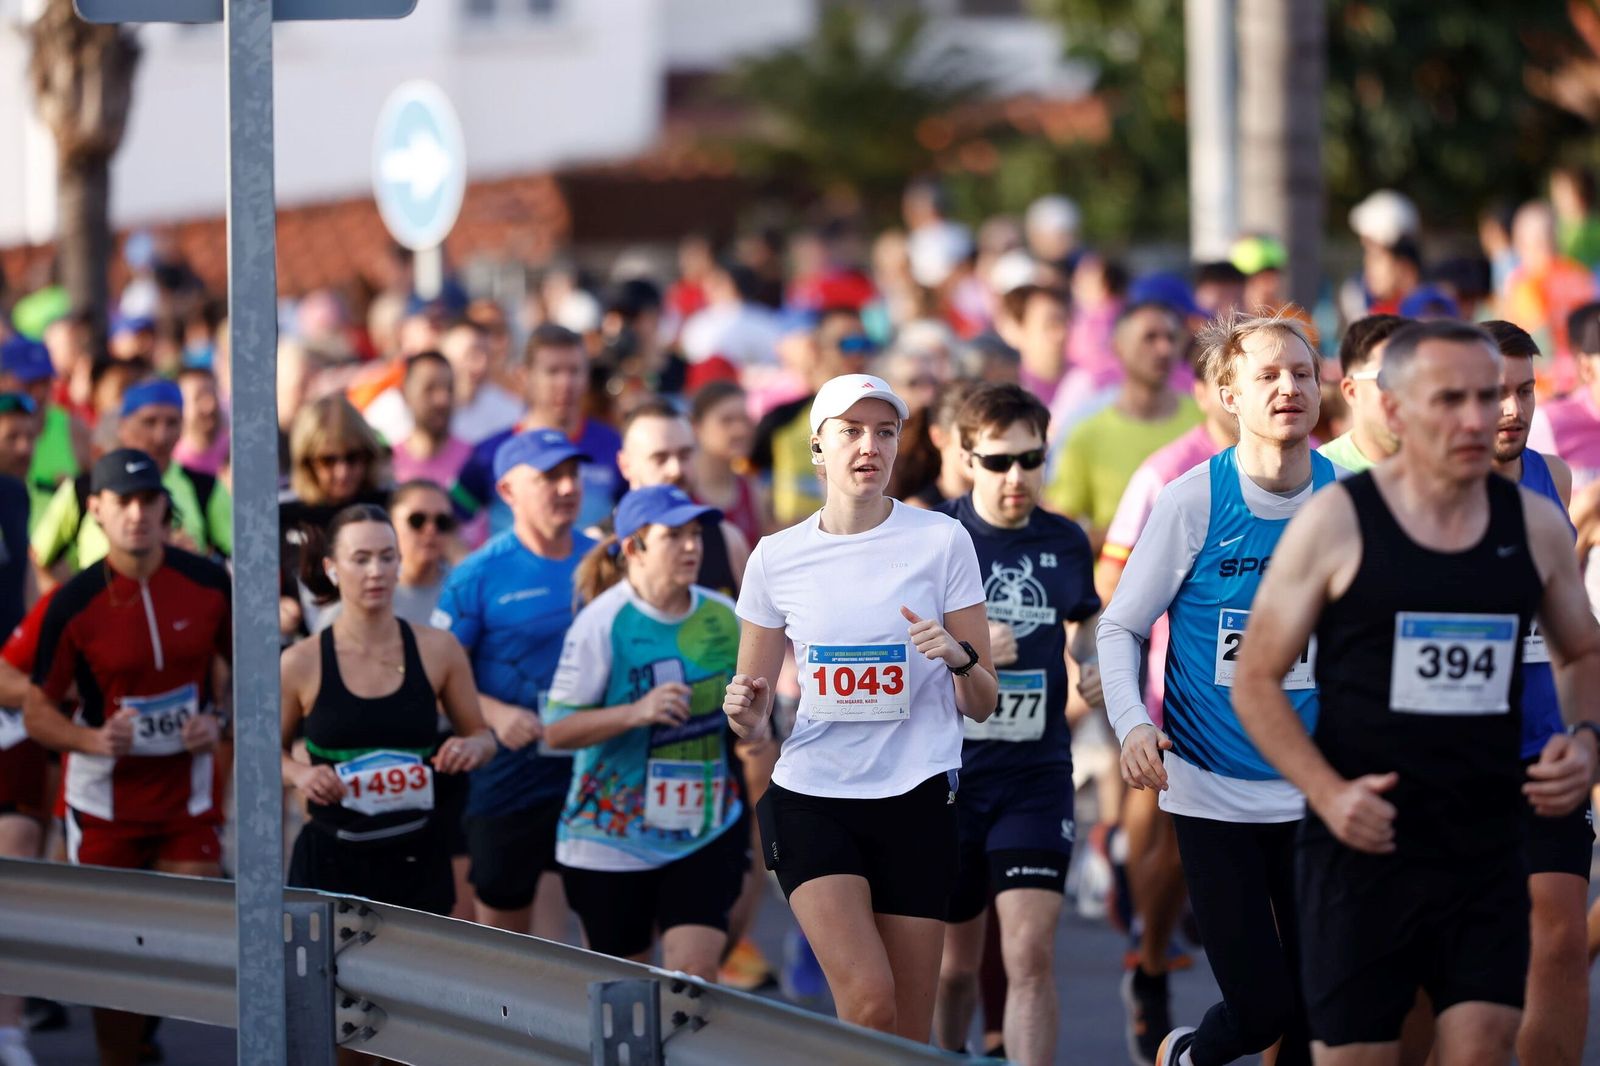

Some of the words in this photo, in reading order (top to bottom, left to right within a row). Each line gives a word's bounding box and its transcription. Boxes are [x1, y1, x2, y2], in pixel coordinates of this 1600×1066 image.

[1418, 644, 1496, 680] 394
[813, 665, 904, 696] 1043
[349, 764, 428, 799] 1493
